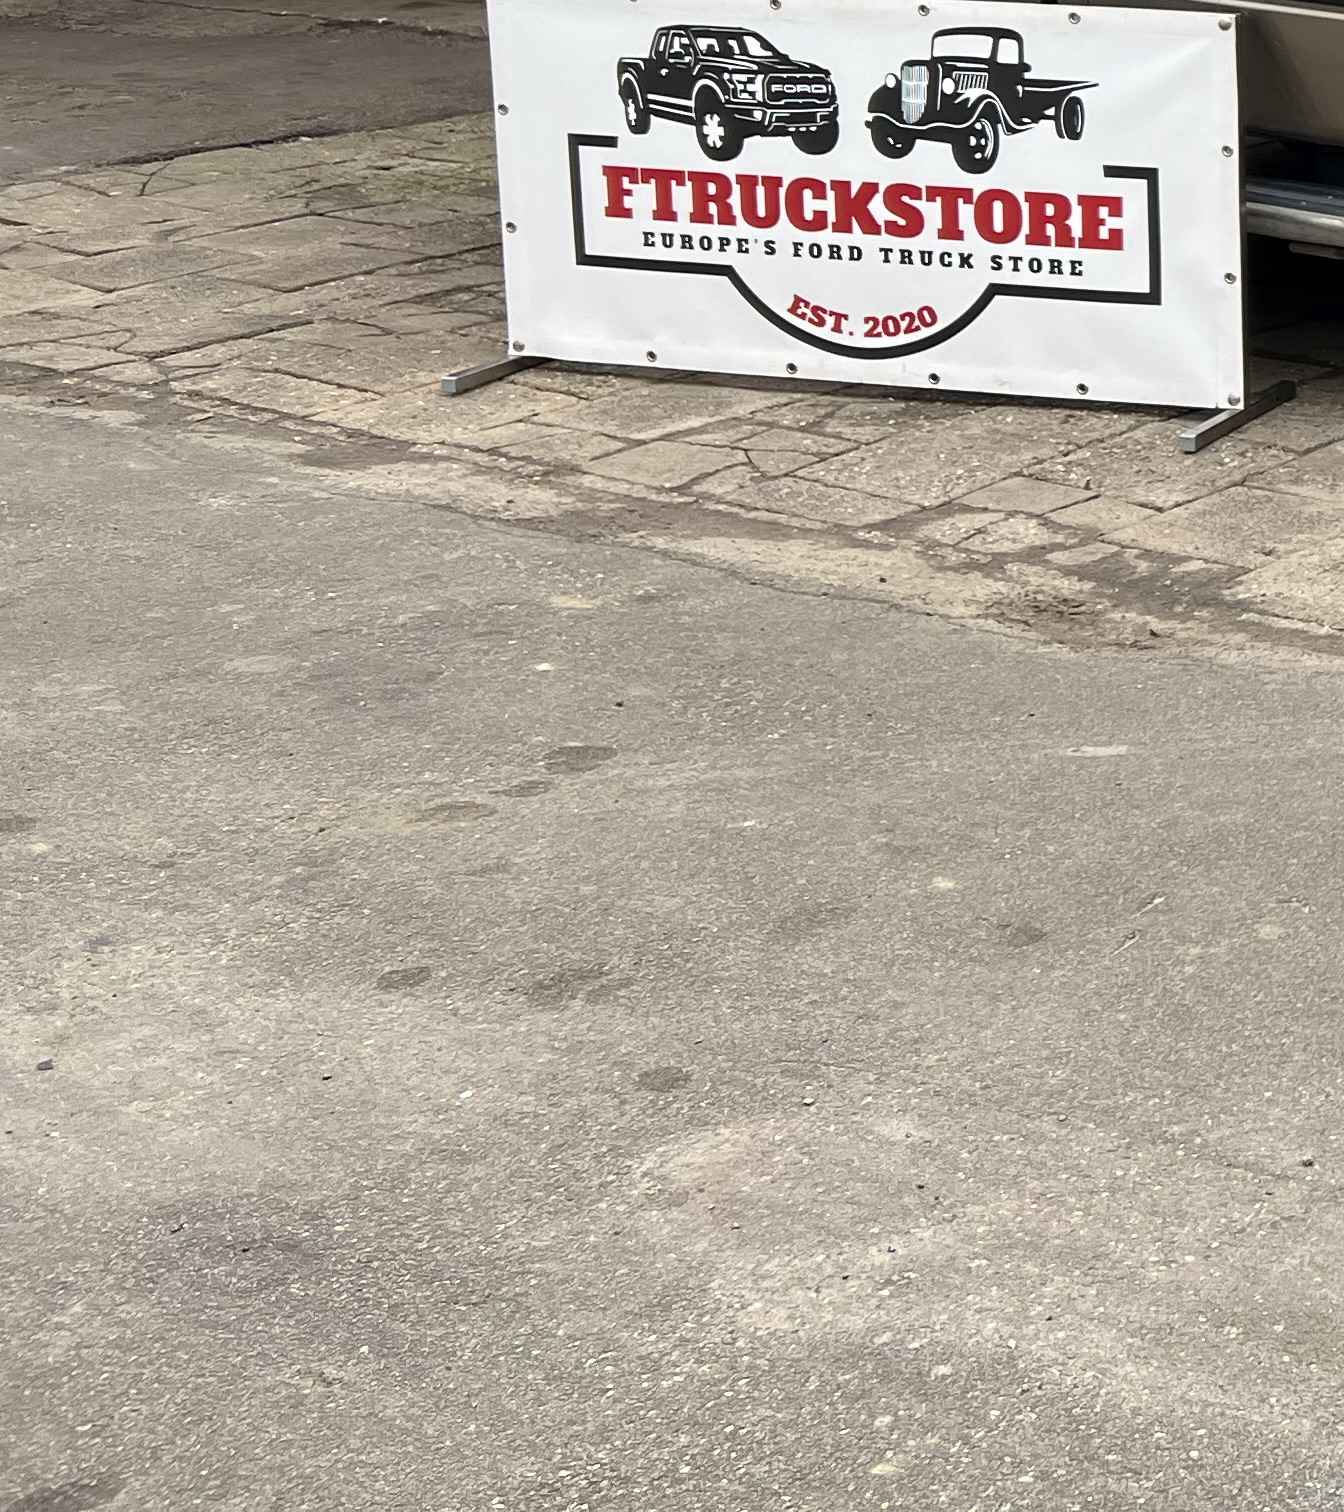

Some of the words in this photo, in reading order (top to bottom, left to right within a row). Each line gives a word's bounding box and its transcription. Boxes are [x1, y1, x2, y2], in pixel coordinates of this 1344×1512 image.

[771, 84, 827, 93] FORD
[602, 165, 1124, 252] FTRUCKSTORE
[642, 231, 777, 256] EUROPE'S
[792, 241, 863, 262] FORD
[878, 247, 974, 269] TRUCK
[990, 254, 1084, 277] STORE
[787, 294, 855, 338] EST.
[863, 305, 939, 339] 2020
